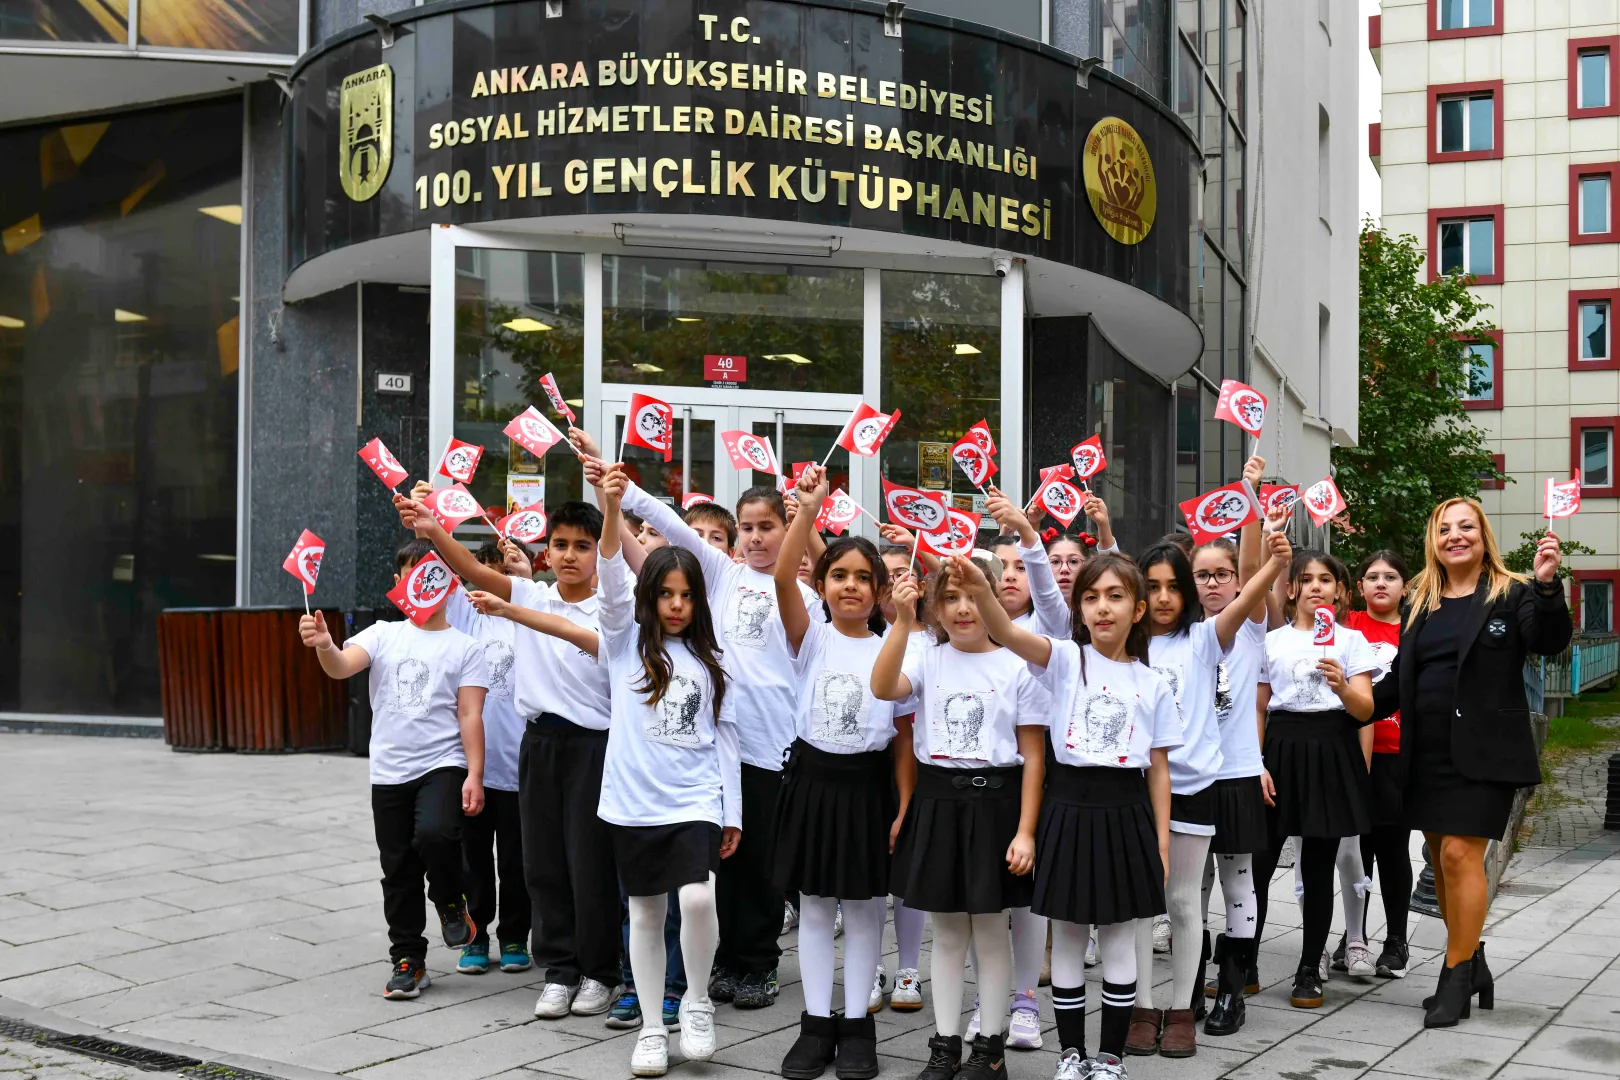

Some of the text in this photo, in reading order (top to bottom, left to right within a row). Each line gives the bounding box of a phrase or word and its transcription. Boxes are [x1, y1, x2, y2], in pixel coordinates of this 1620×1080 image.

[698, 14, 761, 44] T.C.
[345, 69, 386, 90] ANKARA
[471, 52, 993, 126] ANKARA BÜYÜKŞEHİR BELEDİYESİ
[429, 101, 1038, 181] SOSYAL HİZMETLER DAİRESİ BAŞKANLIĞI
[415, 150, 1052, 241] 100. YIL GENÇLİK KÜTÜPHANESİ
[717, 357, 733, 369] 40
[385, 377, 404, 389] 40
[722, 372, 728, 380] A
[515, 433, 535, 449] ATA
[728, 441, 740, 461] ATA
[370, 457, 389, 478] ATA
[1186, 513, 1199, 535] ATA
[398, 599, 418, 617] ATA
